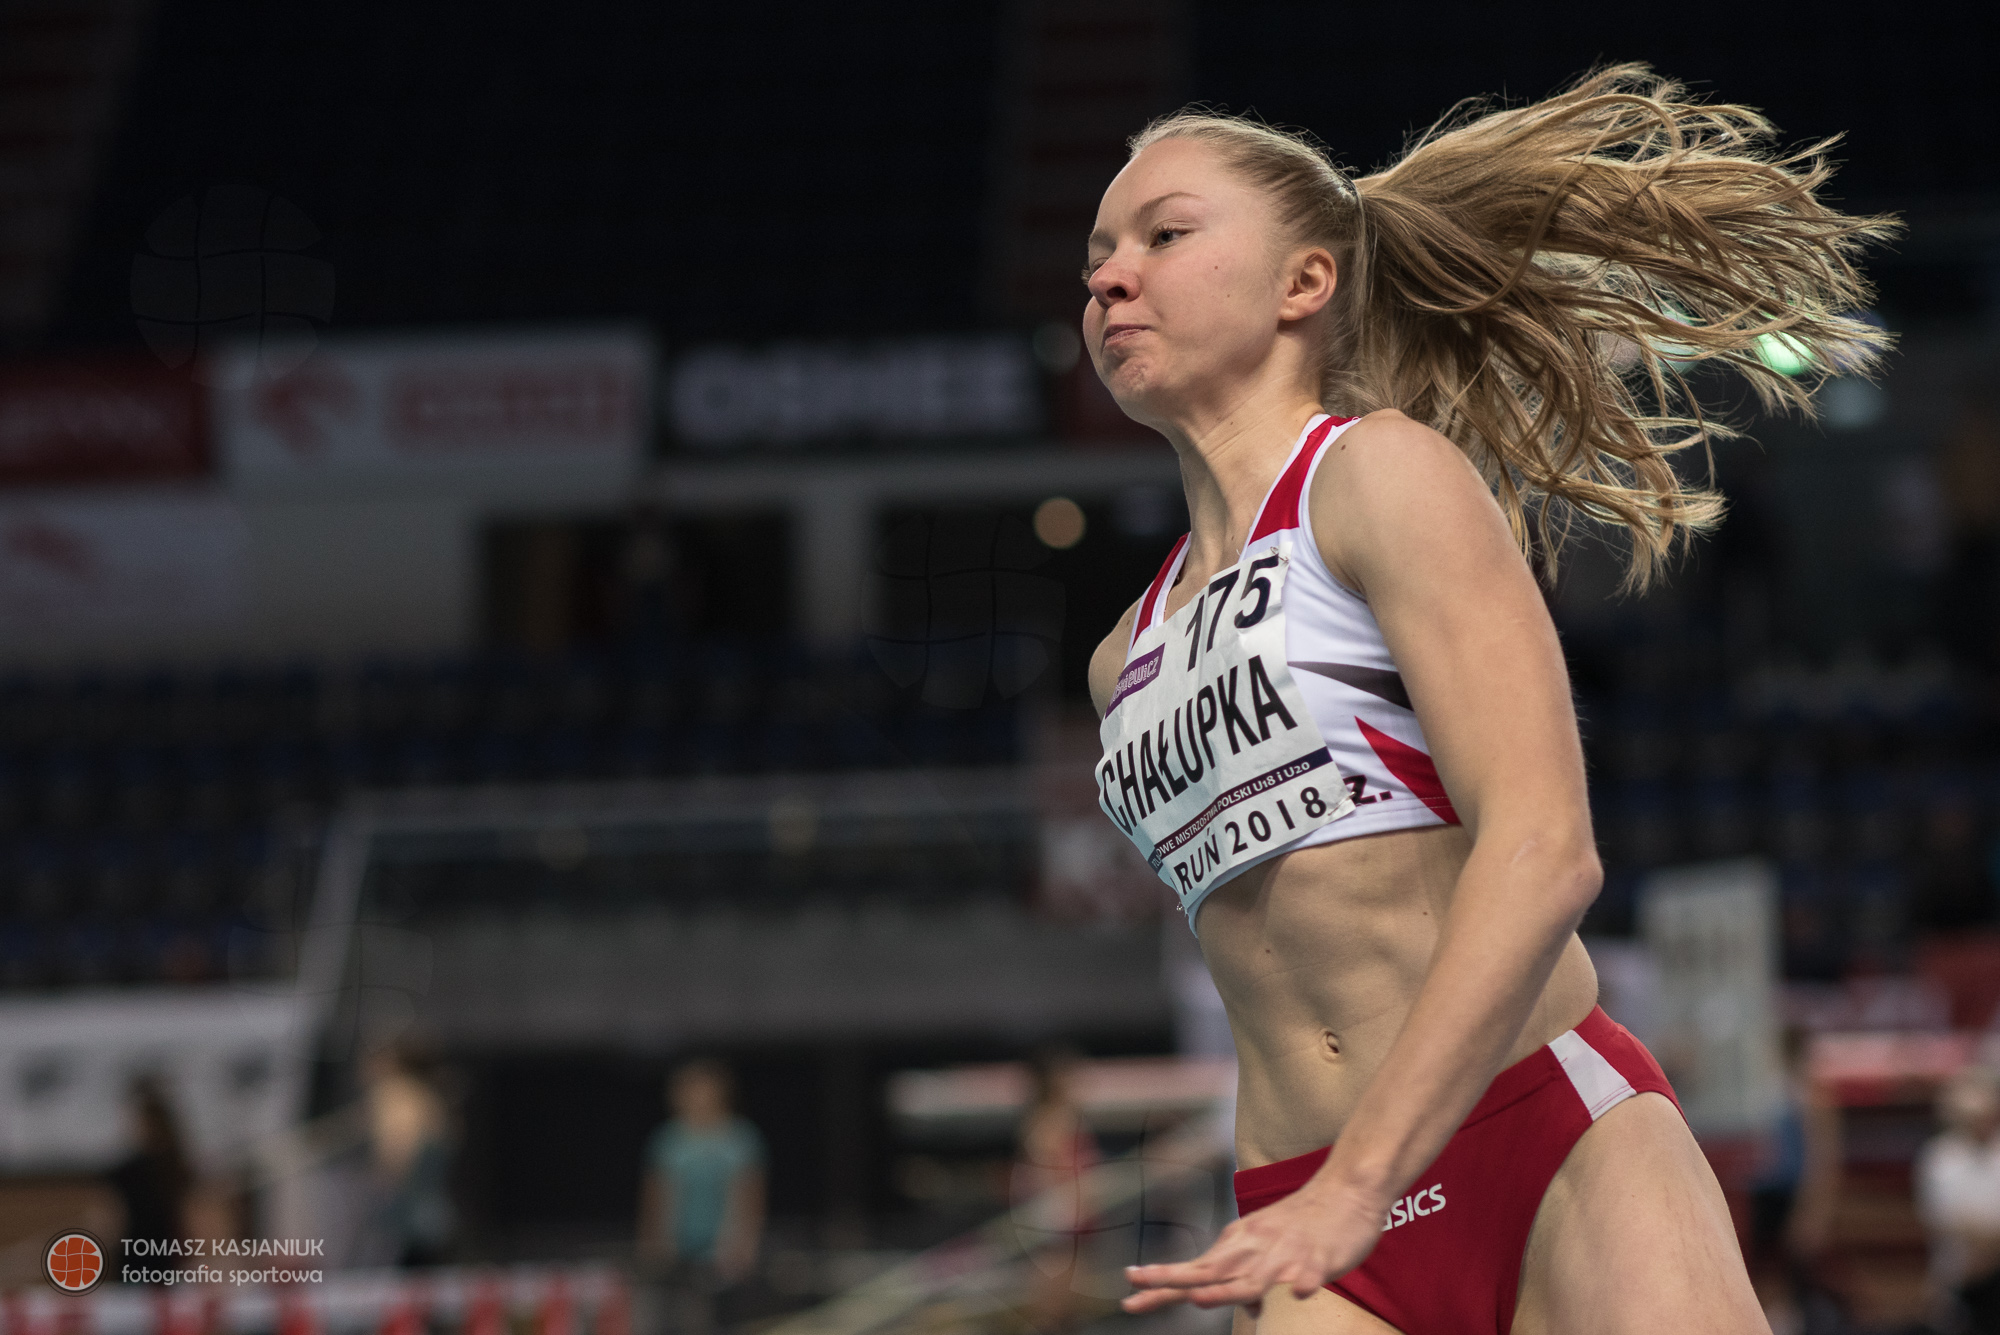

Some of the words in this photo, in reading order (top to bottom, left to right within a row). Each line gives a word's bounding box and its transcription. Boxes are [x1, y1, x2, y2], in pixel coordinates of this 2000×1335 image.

[1184, 554, 1279, 672] 175
[1100, 655, 1298, 836] CHAŁUPKA
[1175, 804, 1218, 846] MISTRZOSTWA
[1216, 785, 1252, 811] POLSKI
[1252, 774, 1276, 792] U18
[1283, 761, 1311, 779] U20
